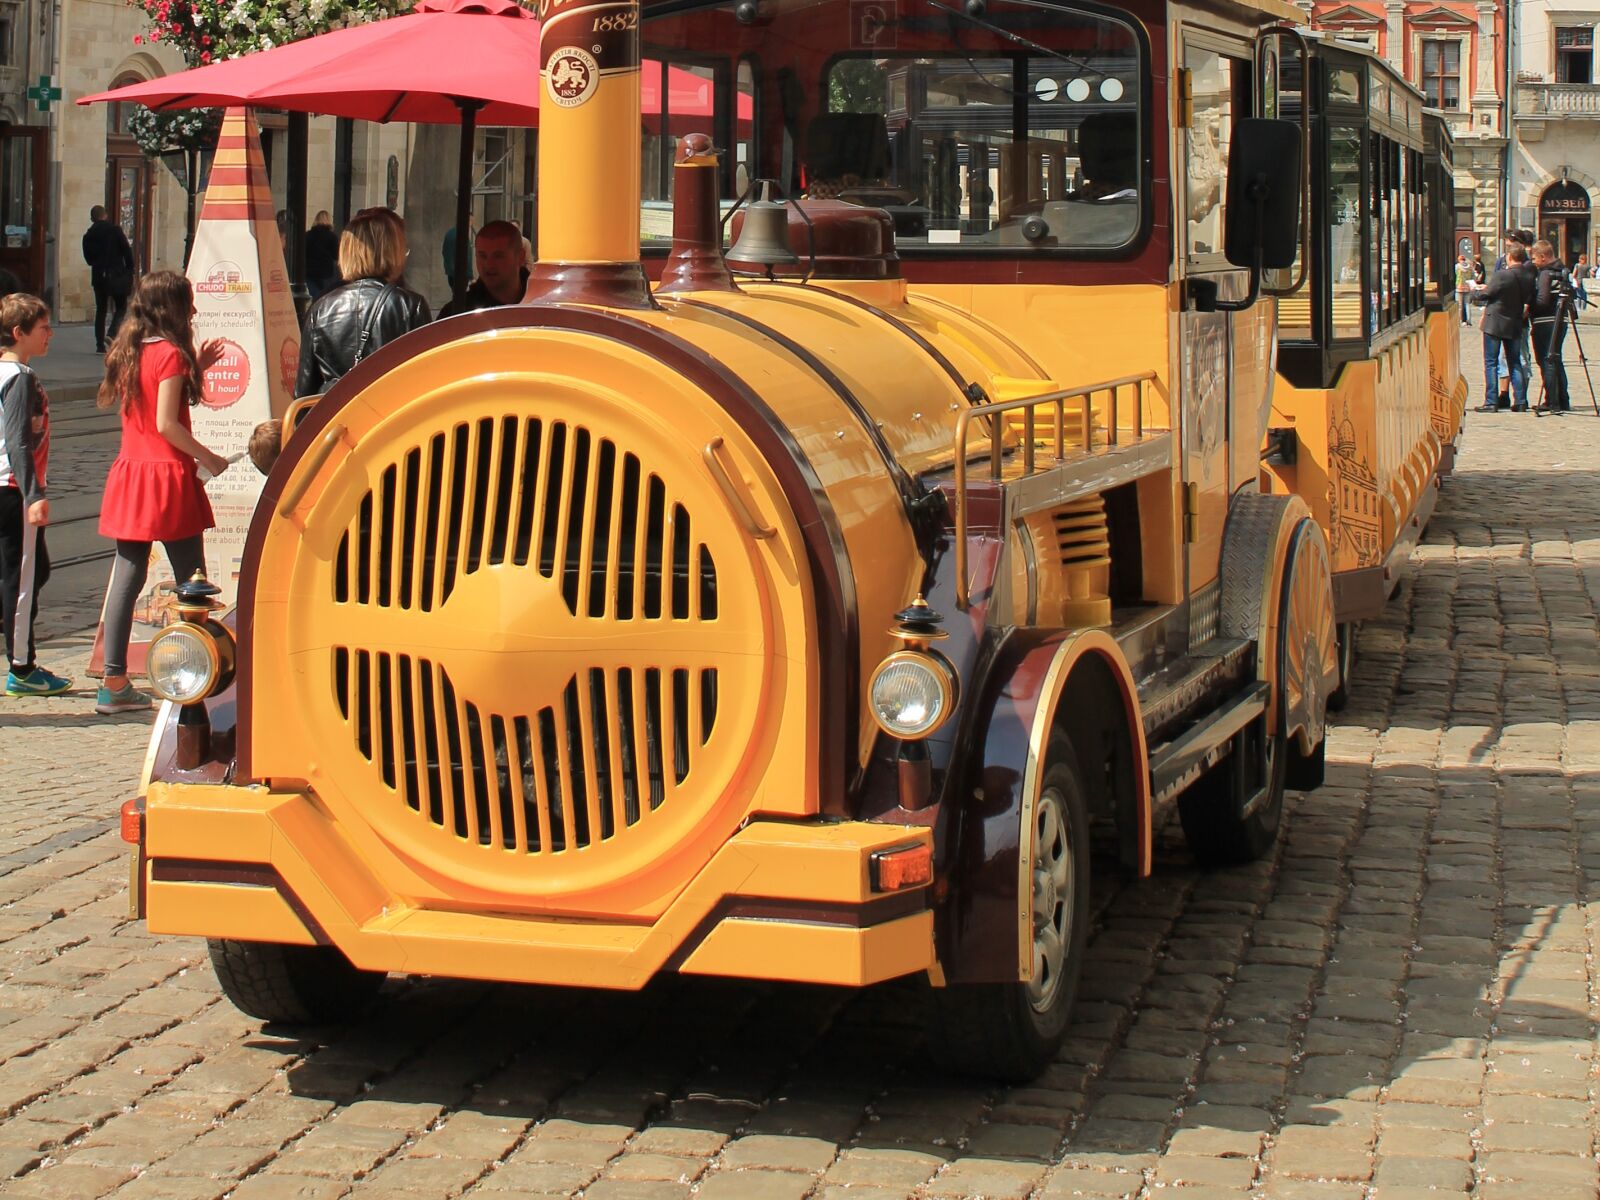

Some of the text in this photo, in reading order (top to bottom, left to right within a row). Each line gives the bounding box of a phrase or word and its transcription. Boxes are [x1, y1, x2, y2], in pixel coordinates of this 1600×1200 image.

[592, 11, 638, 33] 1882
[561, 89, 577, 97] 1882
[1545, 197, 1585, 208] МУЗЕЙ
[198, 284, 250, 292] CHUDO TRAIN
[197, 310, 221, 319] улярні
[220, 320, 256, 328] scheduled!
[205, 371, 240, 380] entre
[218, 385, 240, 393] hour!
[210, 430, 233, 439] Rynok
[236, 525, 249, 533] біл
[219, 536, 240, 544] about
